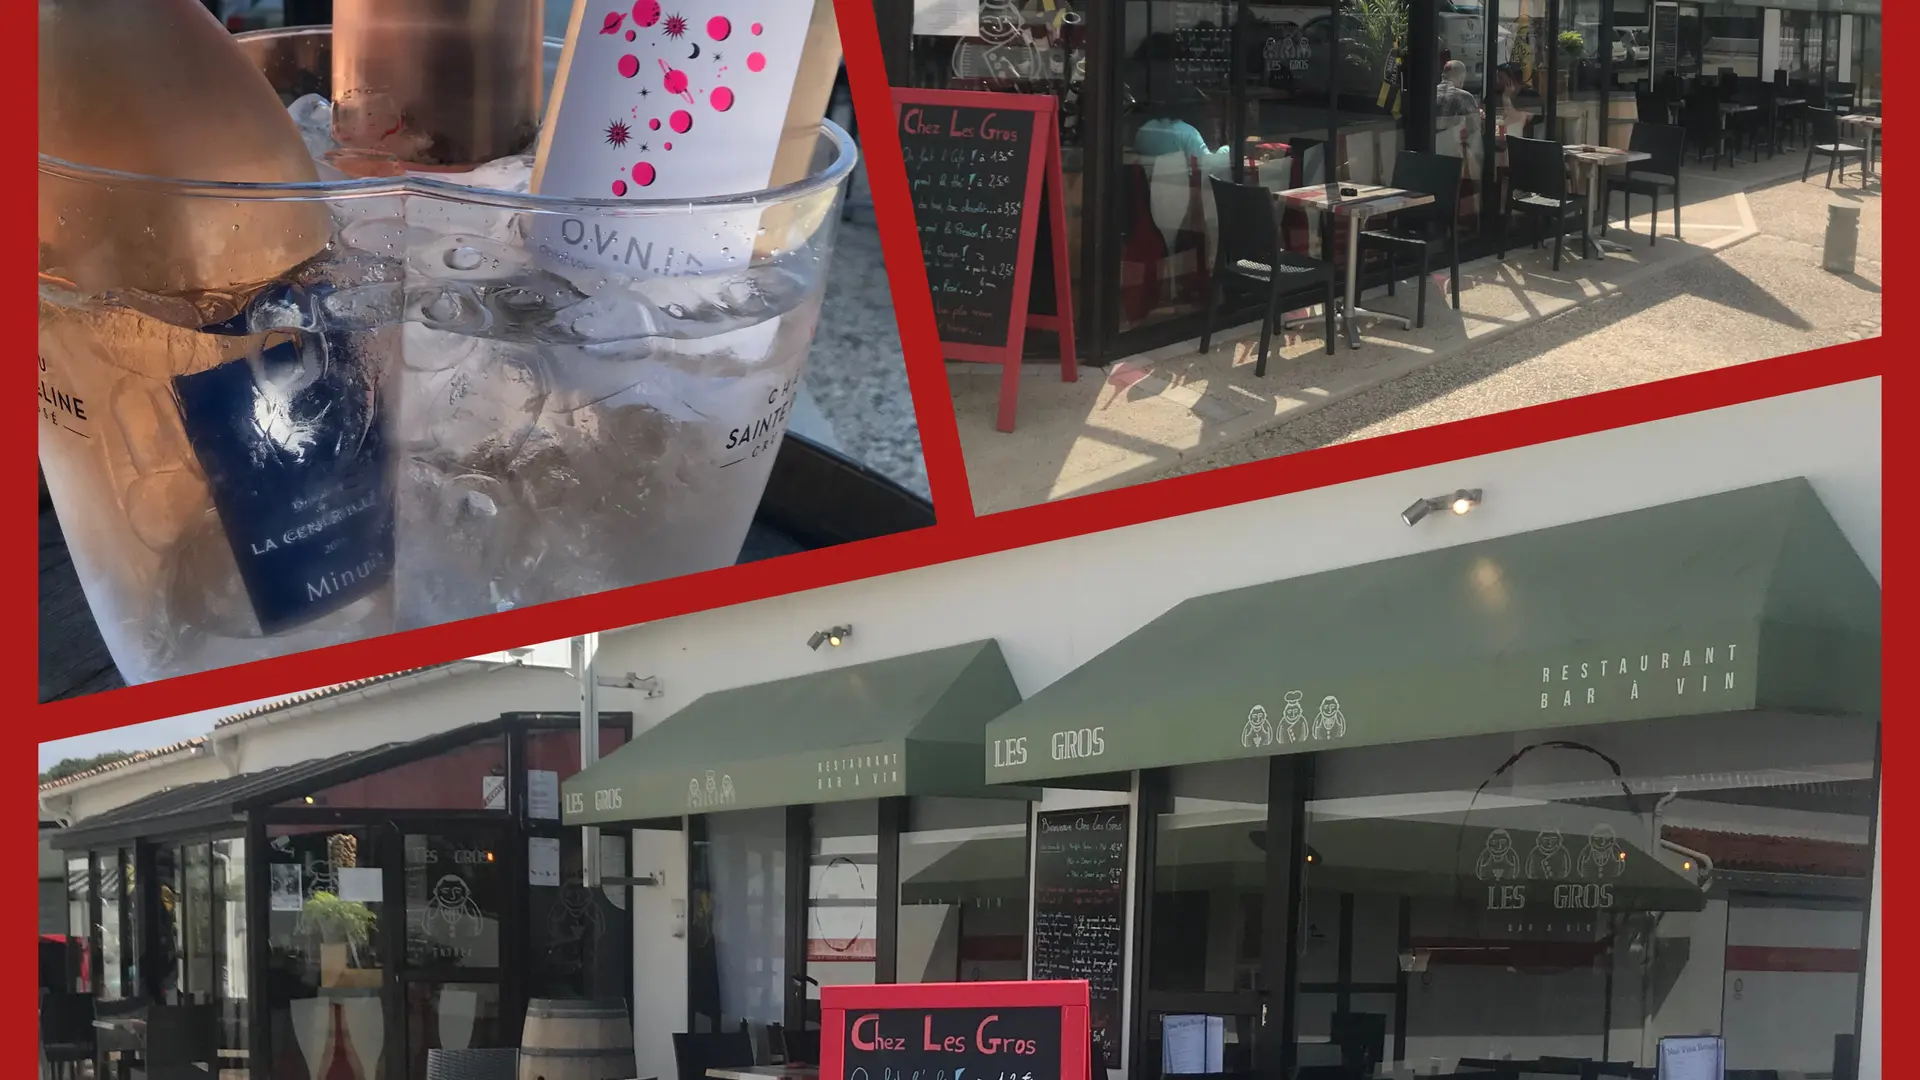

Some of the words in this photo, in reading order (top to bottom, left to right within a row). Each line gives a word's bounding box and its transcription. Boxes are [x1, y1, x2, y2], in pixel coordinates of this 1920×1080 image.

[904, 108, 940, 134] Chez
[949, 109, 974, 137] Les
[980, 112, 1017, 142] Gros
[726, 401, 788, 450] SAINTE
[251, 539, 278, 555] LA
[1542, 644, 1736, 683] RESTAURANT
[1540, 687, 1595, 709] BAR
[1630, 679, 1639, 700] À
[1676, 672, 1734, 695] VIN
[818, 753, 897, 773] RESTAURANT
[994, 737, 1028, 768] LES
[1051, 726, 1105, 761] GROS
[818, 776, 842, 790] BAR
[873, 771, 897, 784] VIN
[566, 792, 583, 814] LES
[595, 788, 622, 811] GROS
[1487, 885, 1526, 910] LES
[1553, 883, 1613, 909] GROS
[851, 1014, 906, 1051] Chez
[923, 1015, 966, 1053] Les
[976, 1015, 1036, 1055] Gros
